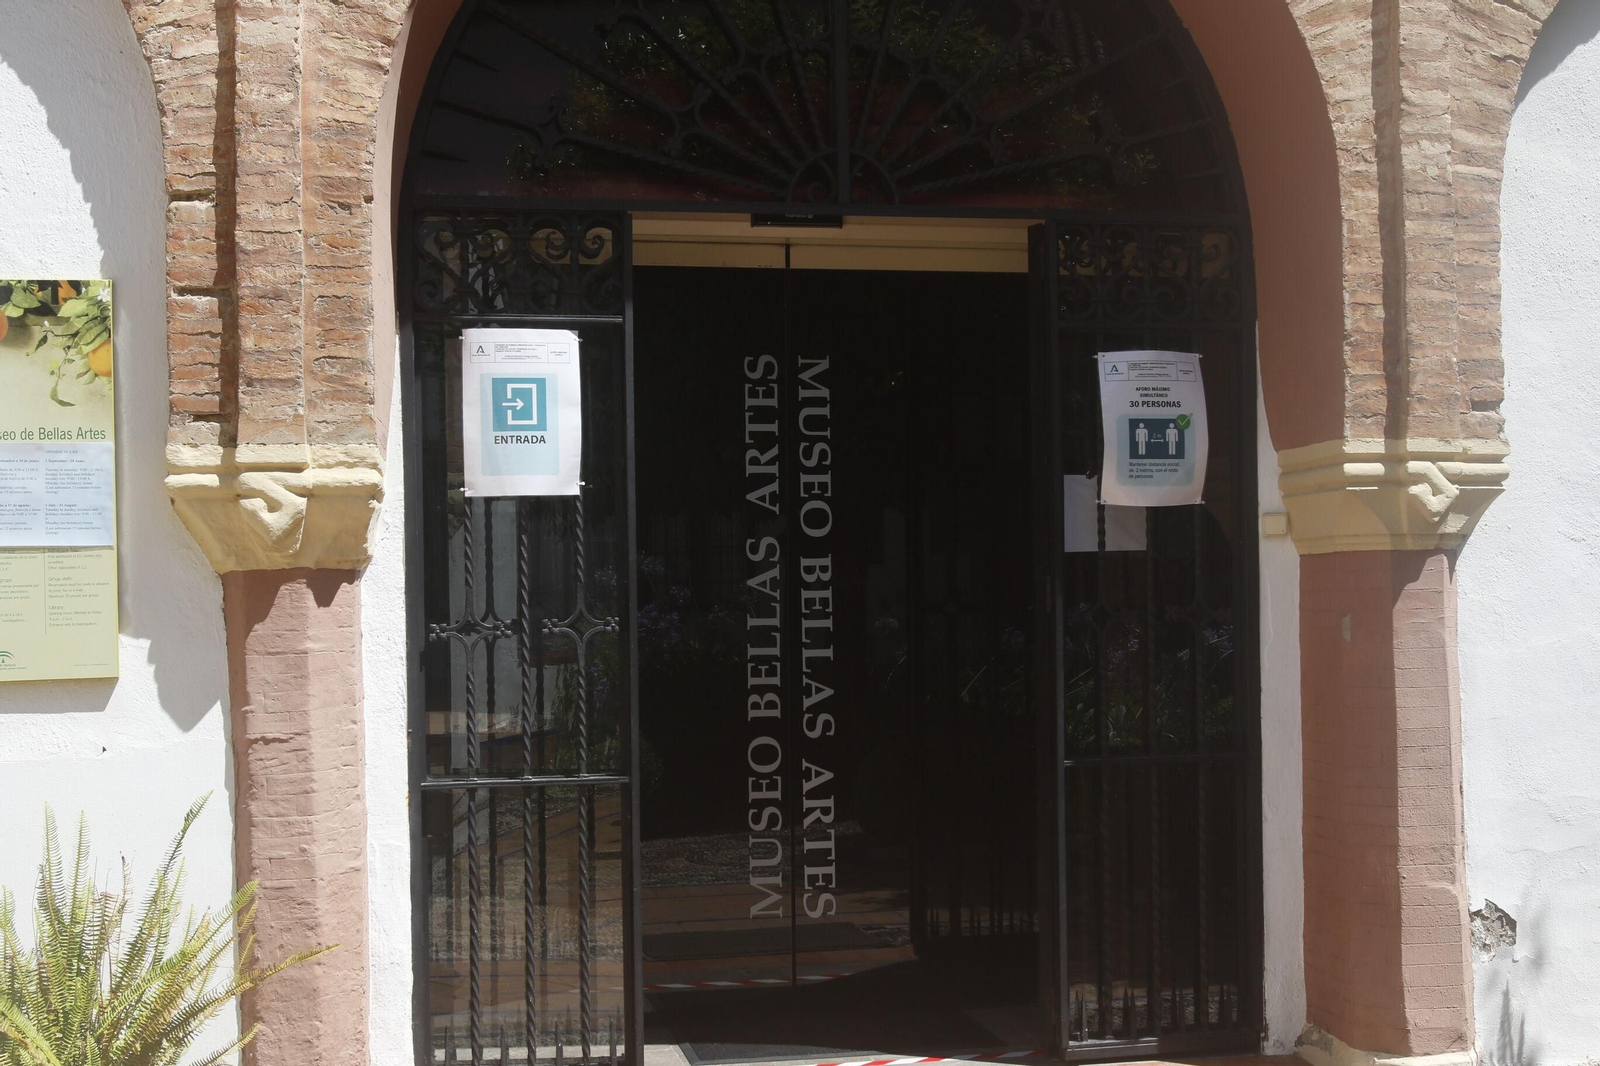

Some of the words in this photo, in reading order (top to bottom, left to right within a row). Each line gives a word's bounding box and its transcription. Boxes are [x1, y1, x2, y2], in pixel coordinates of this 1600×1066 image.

[20, 428, 34, 440] de
[39, 427, 72, 440] Bellas
[76, 427, 106, 440] Artes
[494, 435, 546, 444] ENTRADA
[744, 354, 779, 514] ARTES
[798, 355, 832, 537] MUSEO
[746, 536, 781, 722] BELLAS
[800, 554, 835, 738] BELLAS
[748, 736, 783, 918] MUSEO
[802, 758, 836, 918] ARTES
